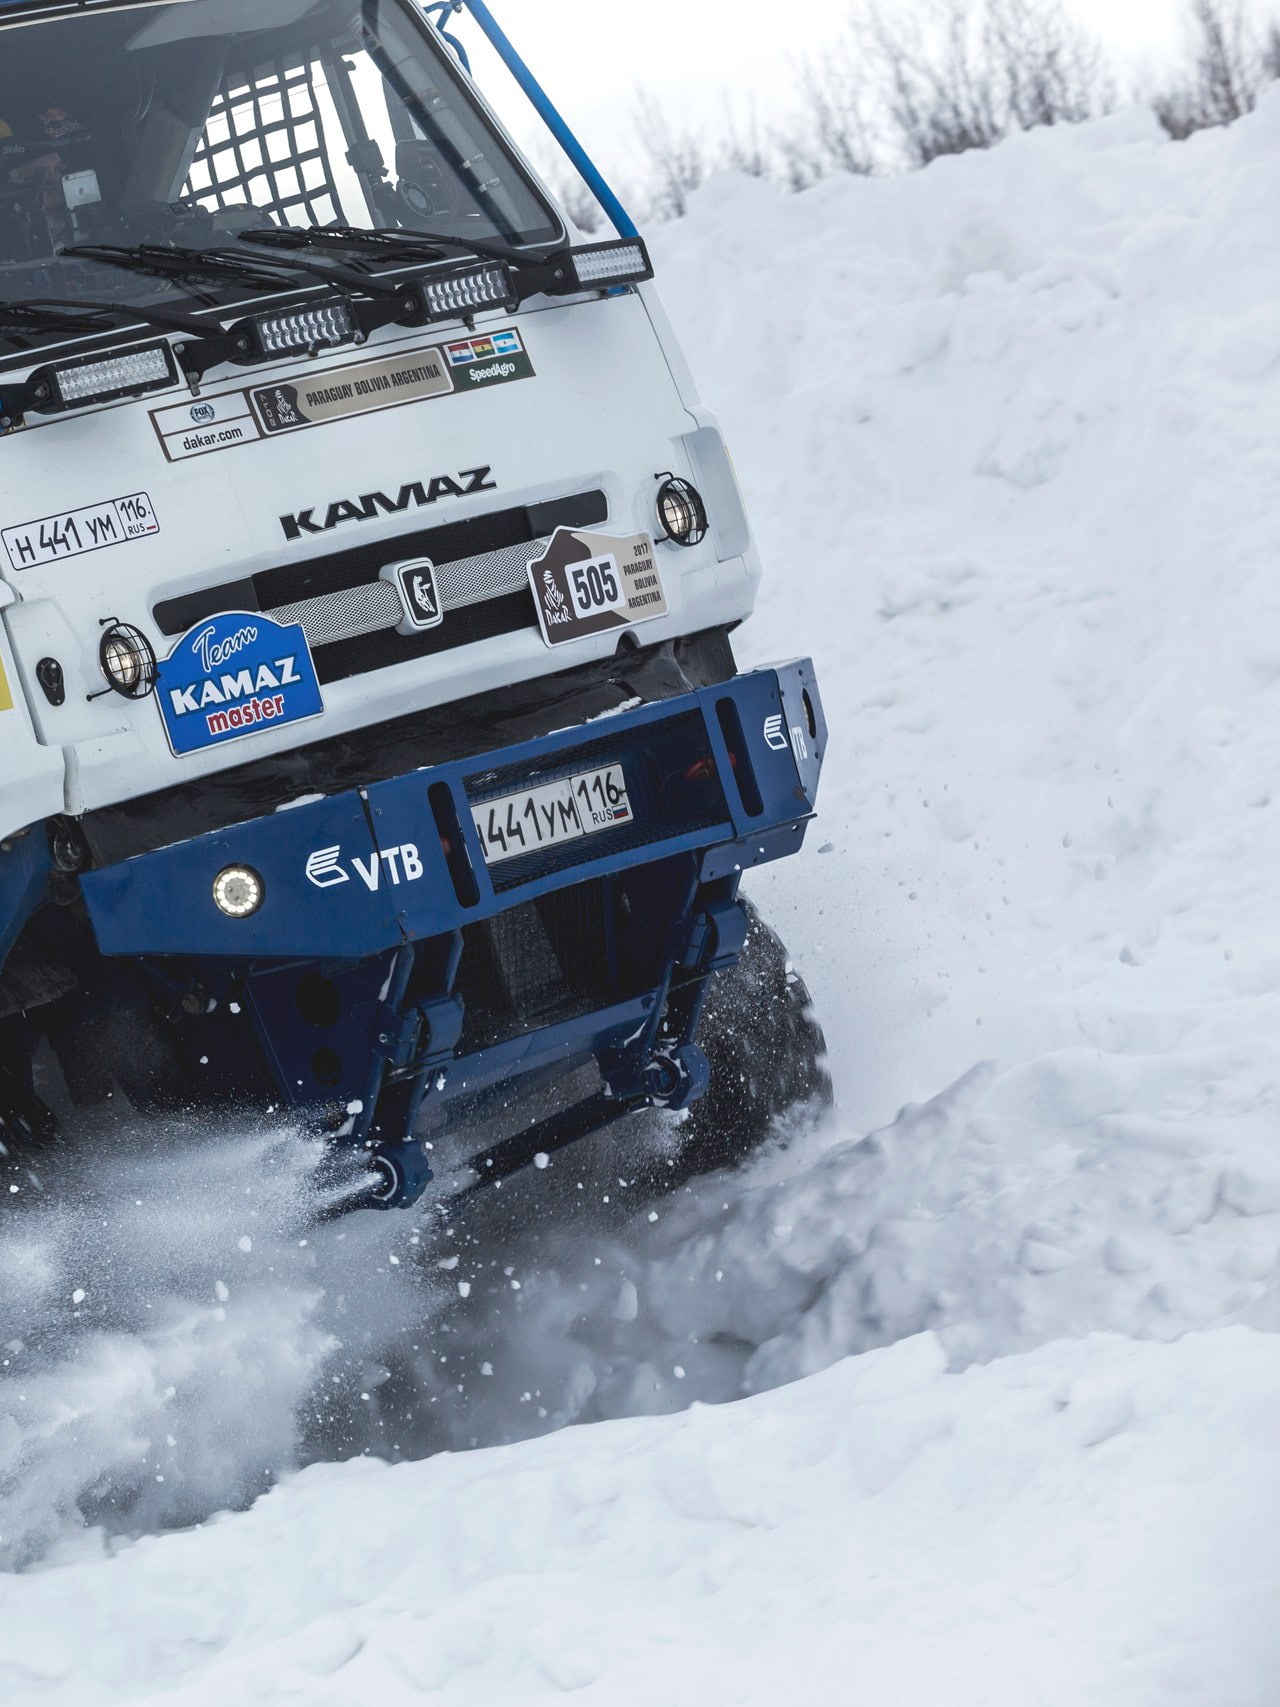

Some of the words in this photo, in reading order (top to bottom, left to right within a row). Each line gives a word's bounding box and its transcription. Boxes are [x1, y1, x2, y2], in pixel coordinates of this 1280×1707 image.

[469, 362, 515, 382] SpeedAgro
[305, 385, 353, 407] PARAGUAY
[356, 375, 391, 396] BOLIVIA
[391, 364, 441, 387] ARGENTINA
[194, 406, 210, 417] FOX
[183, 428, 243, 450] dakar.com
[120, 498, 147, 521] 116
[279, 464, 498, 541] KAMAZ
[128, 523, 146, 535] RUS
[633, 543, 649, 556] 2017
[623, 559, 653, 576] PARAGUAY
[572, 561, 618, 610] 505
[634, 575, 658, 590] BOLIVIA
[628, 591, 662, 609] ARGENTINA
[545, 605, 572, 626] DAKAR
[192, 626, 257, 673] Team
[170, 656, 301, 715] KAMAZ
[206, 694, 285, 735] master
[577, 772, 619, 812] 116
[591, 808, 613, 825] RUS
[351, 843, 423, 892] VTB
